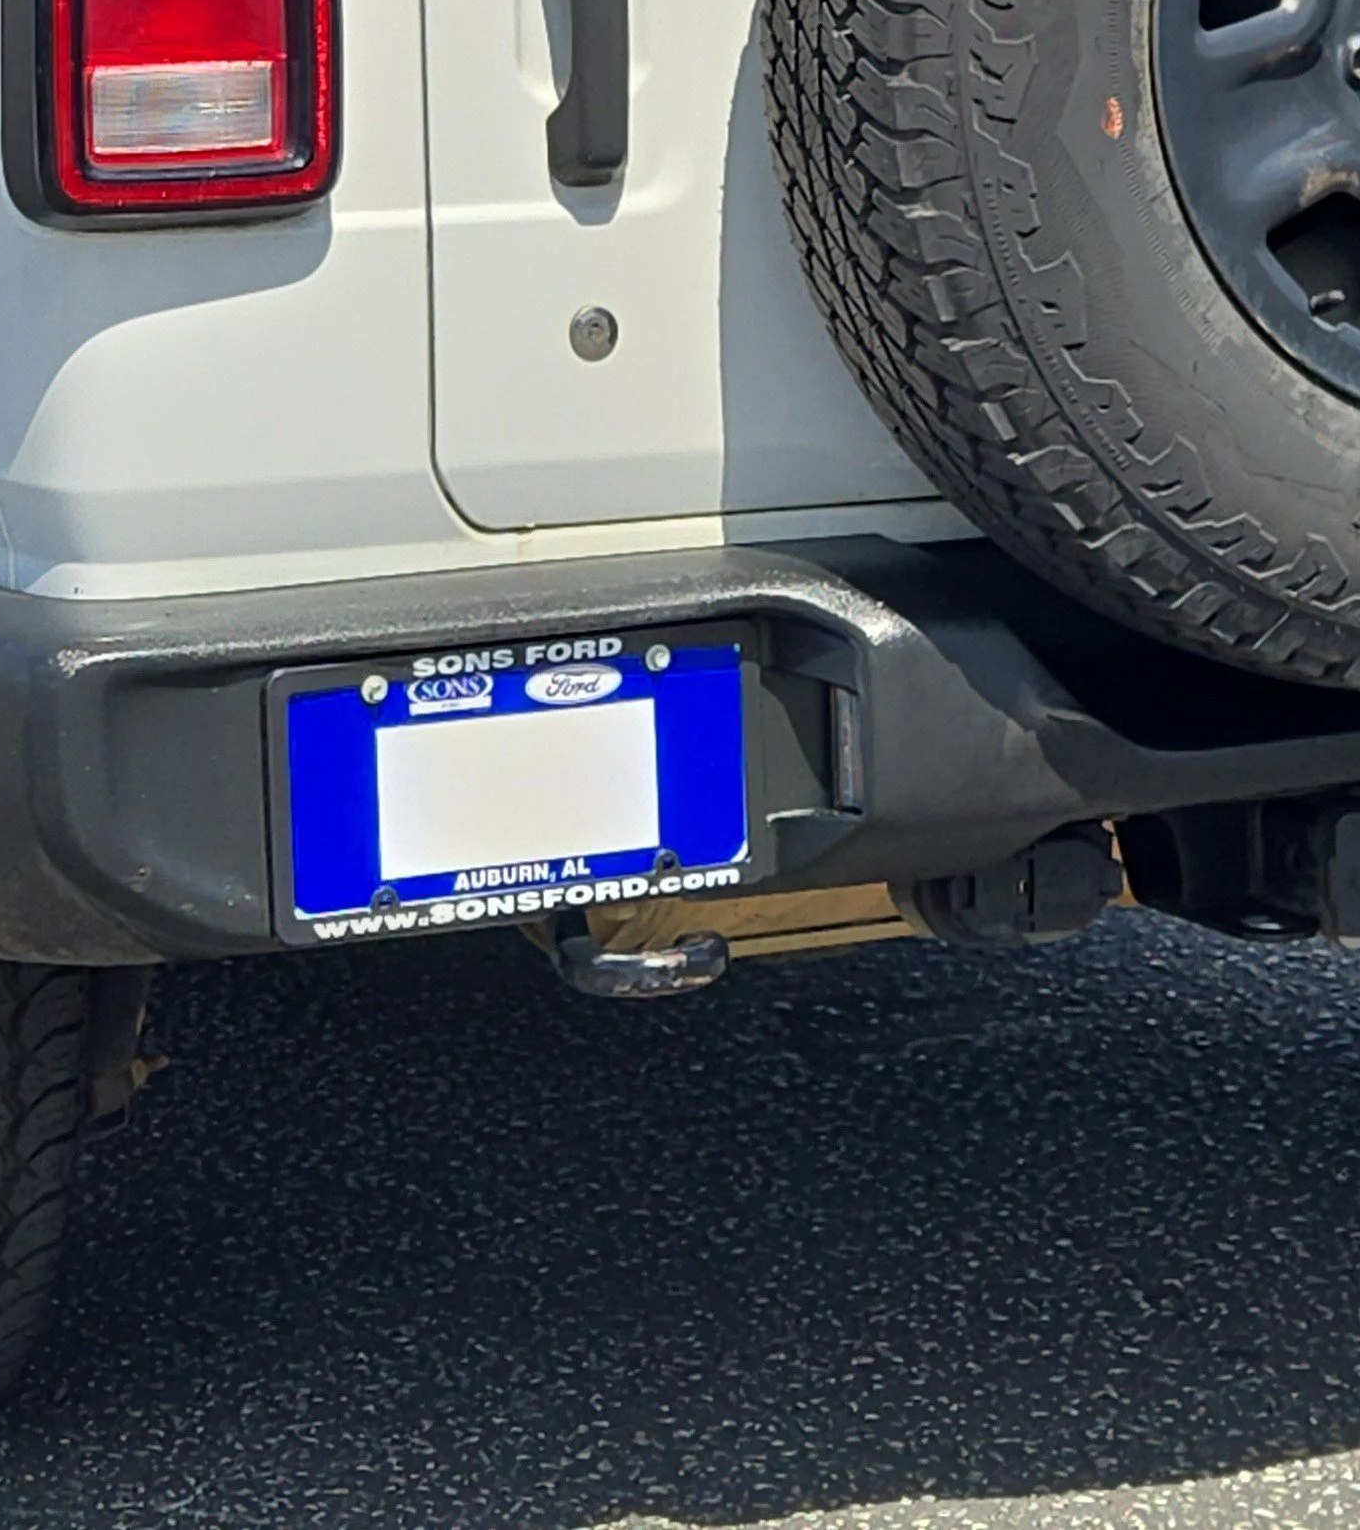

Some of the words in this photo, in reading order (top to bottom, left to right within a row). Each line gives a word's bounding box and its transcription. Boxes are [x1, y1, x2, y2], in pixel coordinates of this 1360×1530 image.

[412, 648, 515, 679] SONS
[524, 636, 623, 666] FORD
[420, 673, 482, 701] SONS
[544, 670, 601, 697] Ford
[452, 861, 556, 892] AUBURN,
[560, 856, 592, 879] AL
[312, 867, 741, 940] www.SONSFORD.com
